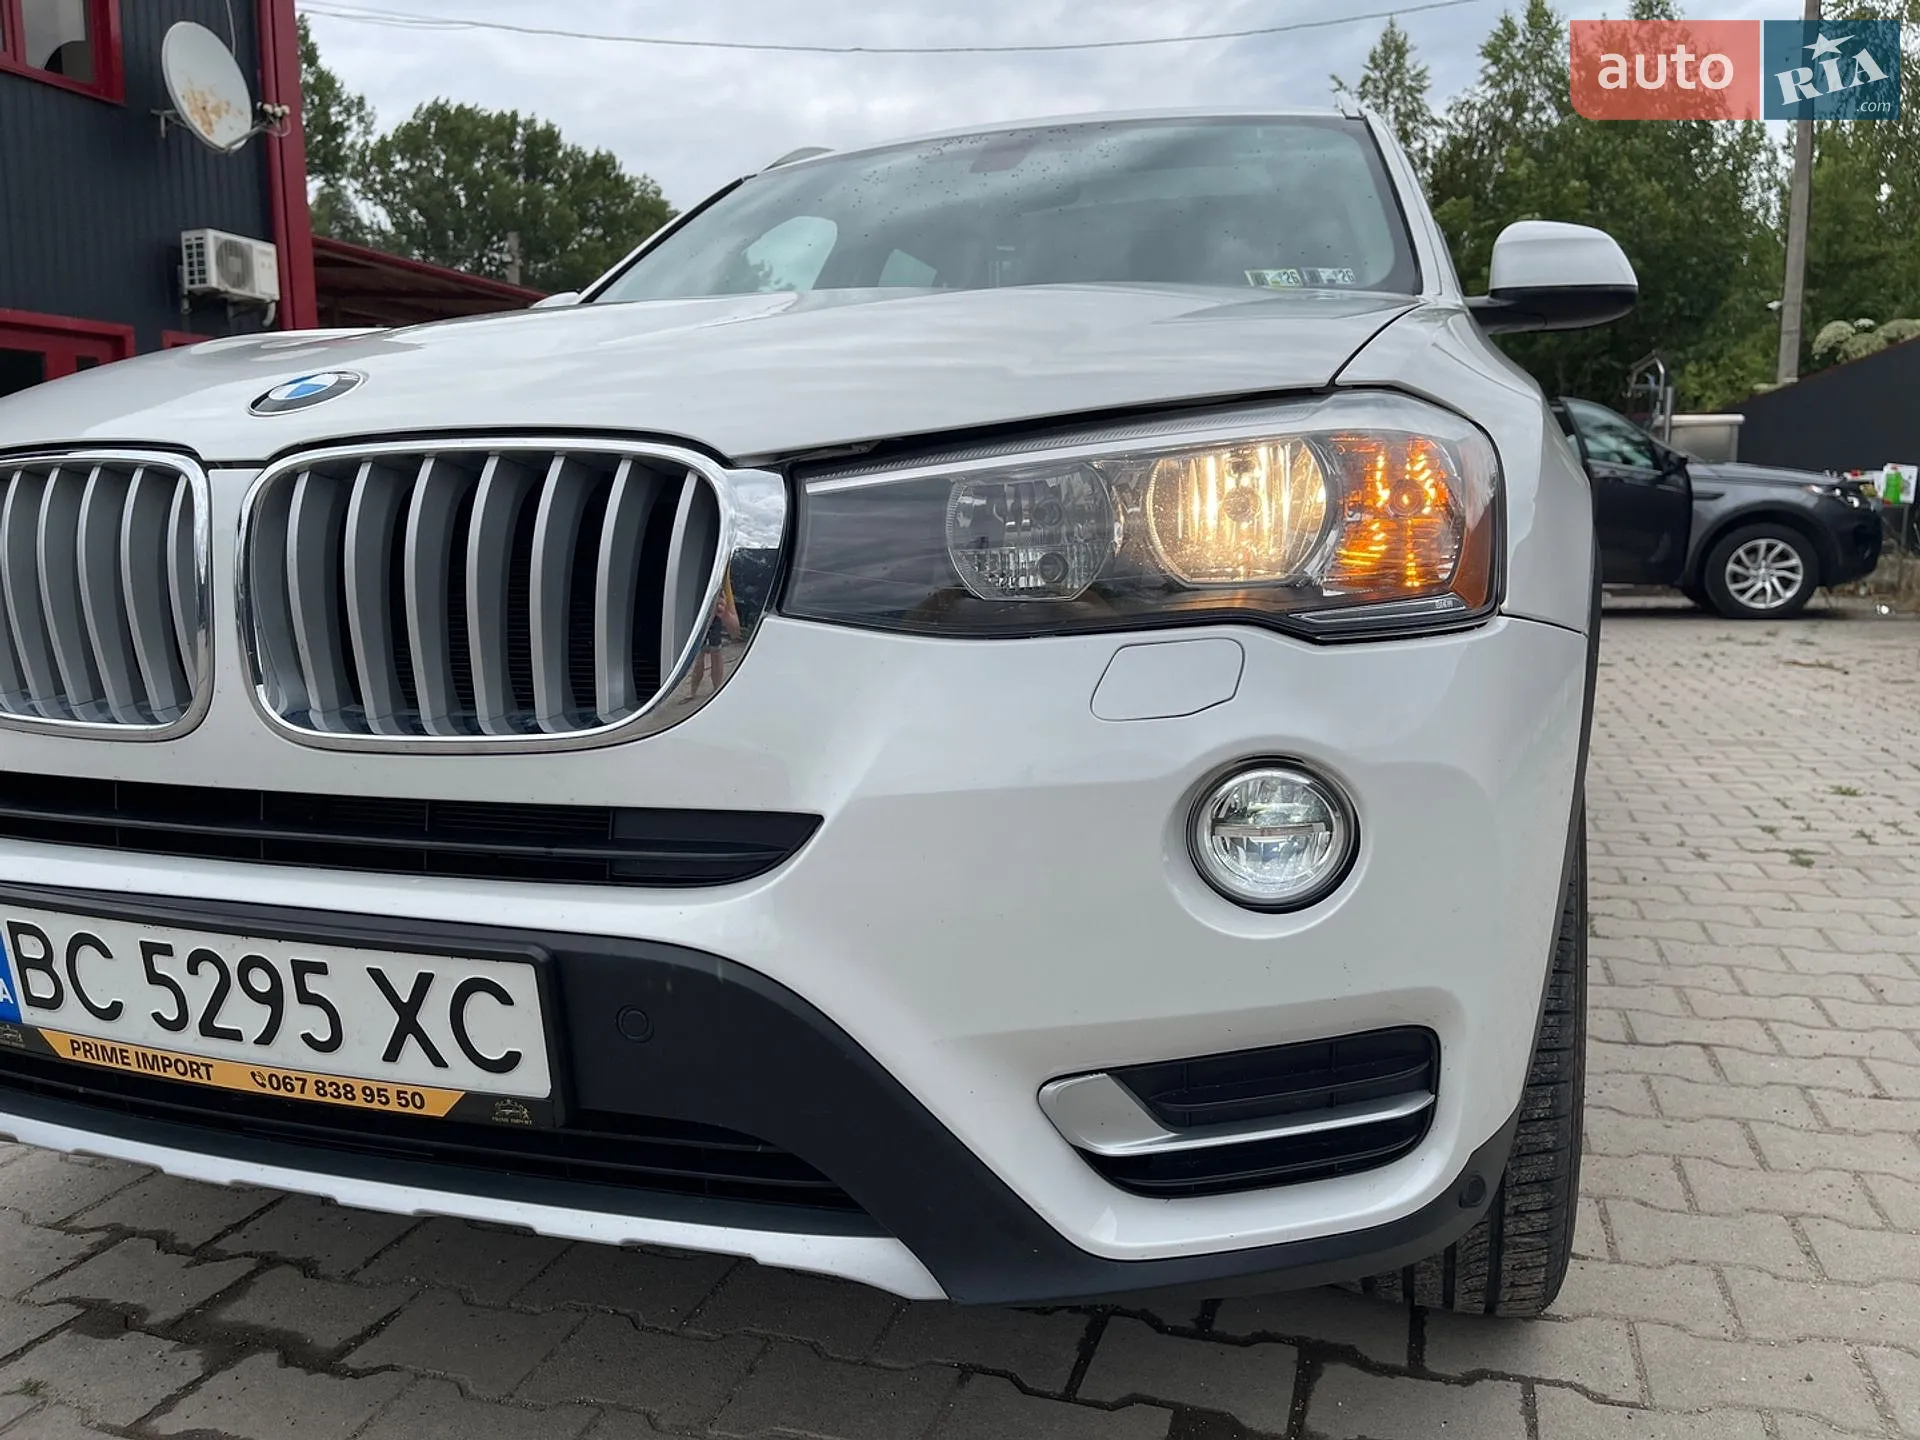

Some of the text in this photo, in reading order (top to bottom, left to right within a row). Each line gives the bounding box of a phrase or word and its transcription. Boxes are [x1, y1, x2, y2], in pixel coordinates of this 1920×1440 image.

[6, 919, 523, 1075] BC 5295 XC
[69, 1038, 426, 1110] PRIME IMPORT 067 838 95 50
